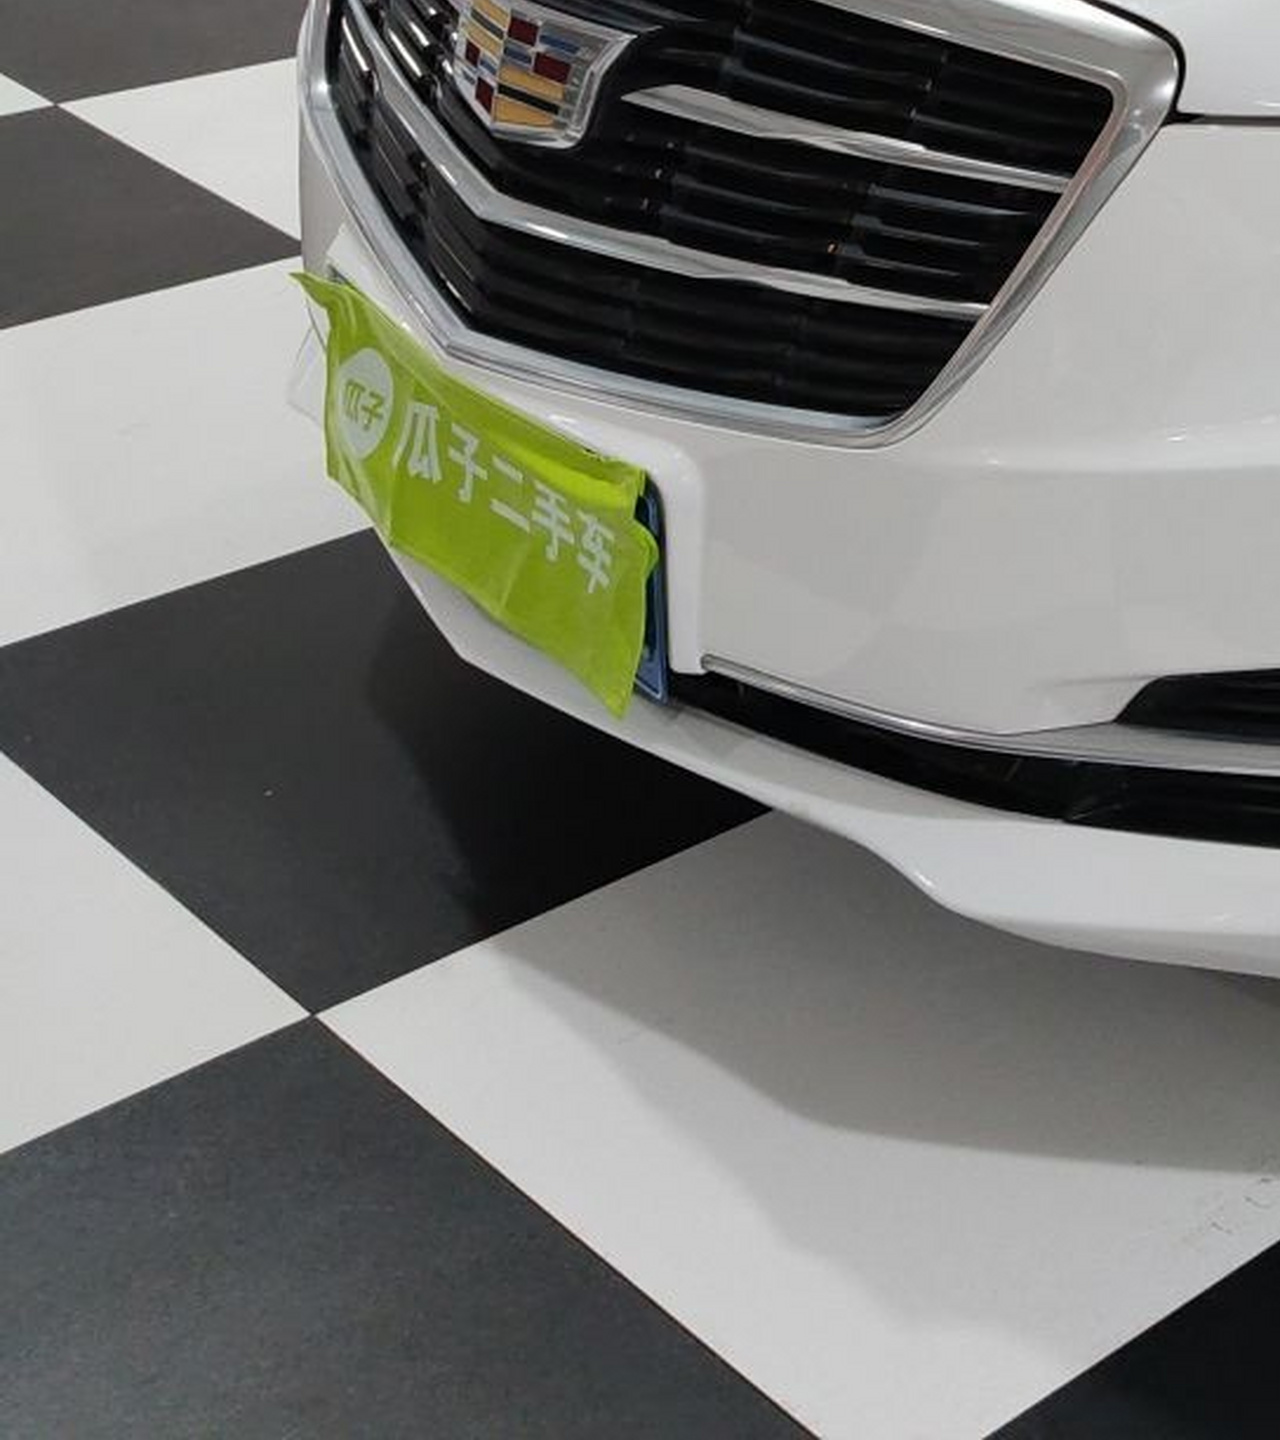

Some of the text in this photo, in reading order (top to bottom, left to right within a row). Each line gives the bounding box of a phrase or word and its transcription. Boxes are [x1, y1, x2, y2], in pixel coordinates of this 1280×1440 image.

[394, 398, 615, 594] 瓜子二手车
